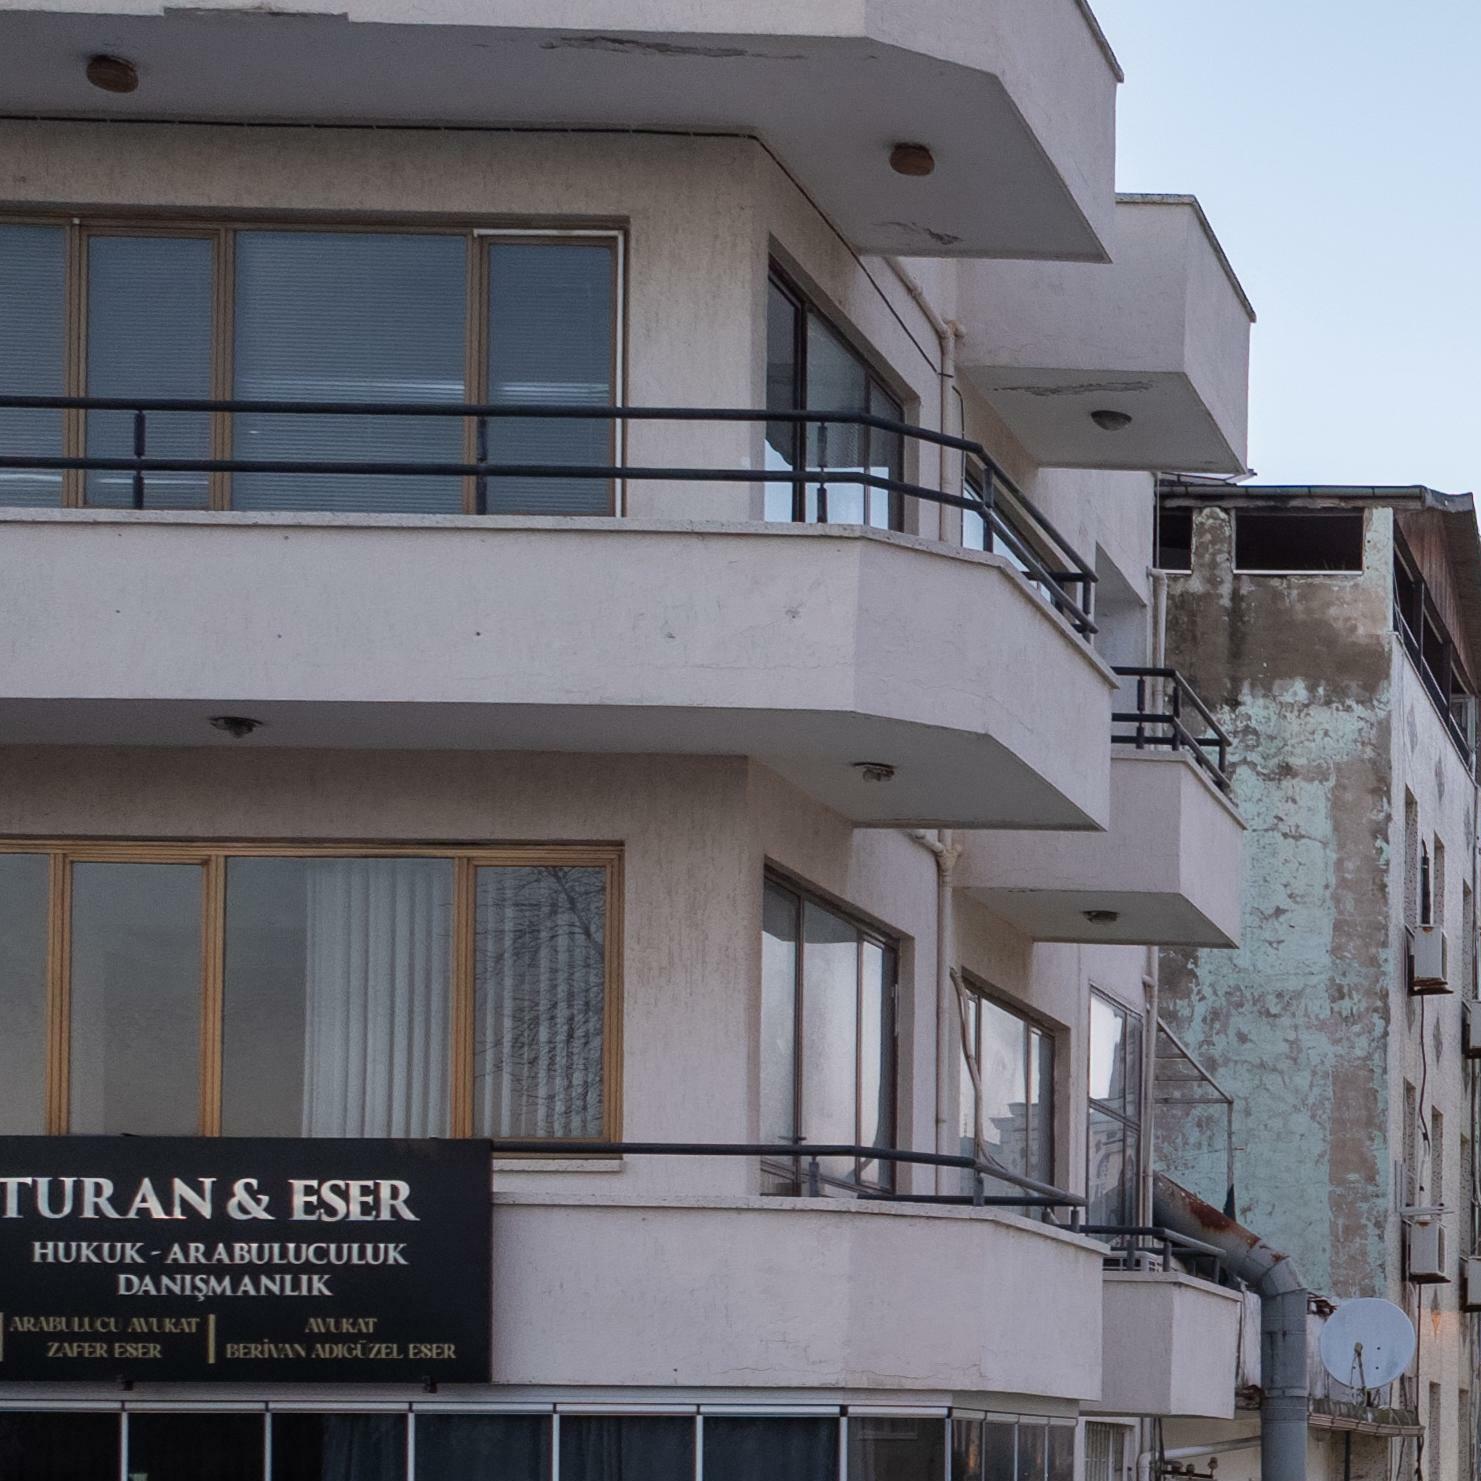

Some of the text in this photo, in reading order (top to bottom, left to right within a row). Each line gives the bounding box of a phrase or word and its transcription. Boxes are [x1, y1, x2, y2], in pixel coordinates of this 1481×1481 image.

[0, 1176, 421, 1222] TURAN & ESER
[32, 1241, 146, 1264] HUKUK
[165, 1242, 409, 1266] ARABULUCULUK
[117, 1273, 334, 1302] DANIŞMANLIK
[9, 1316, 201, 1334] ARABULUCU AVUKAT
[305, 1317, 378, 1334] AVUKAT
[47, 1342, 163, 1359] ZAFER ESER
[408, 1343, 457, 1360] ESER
